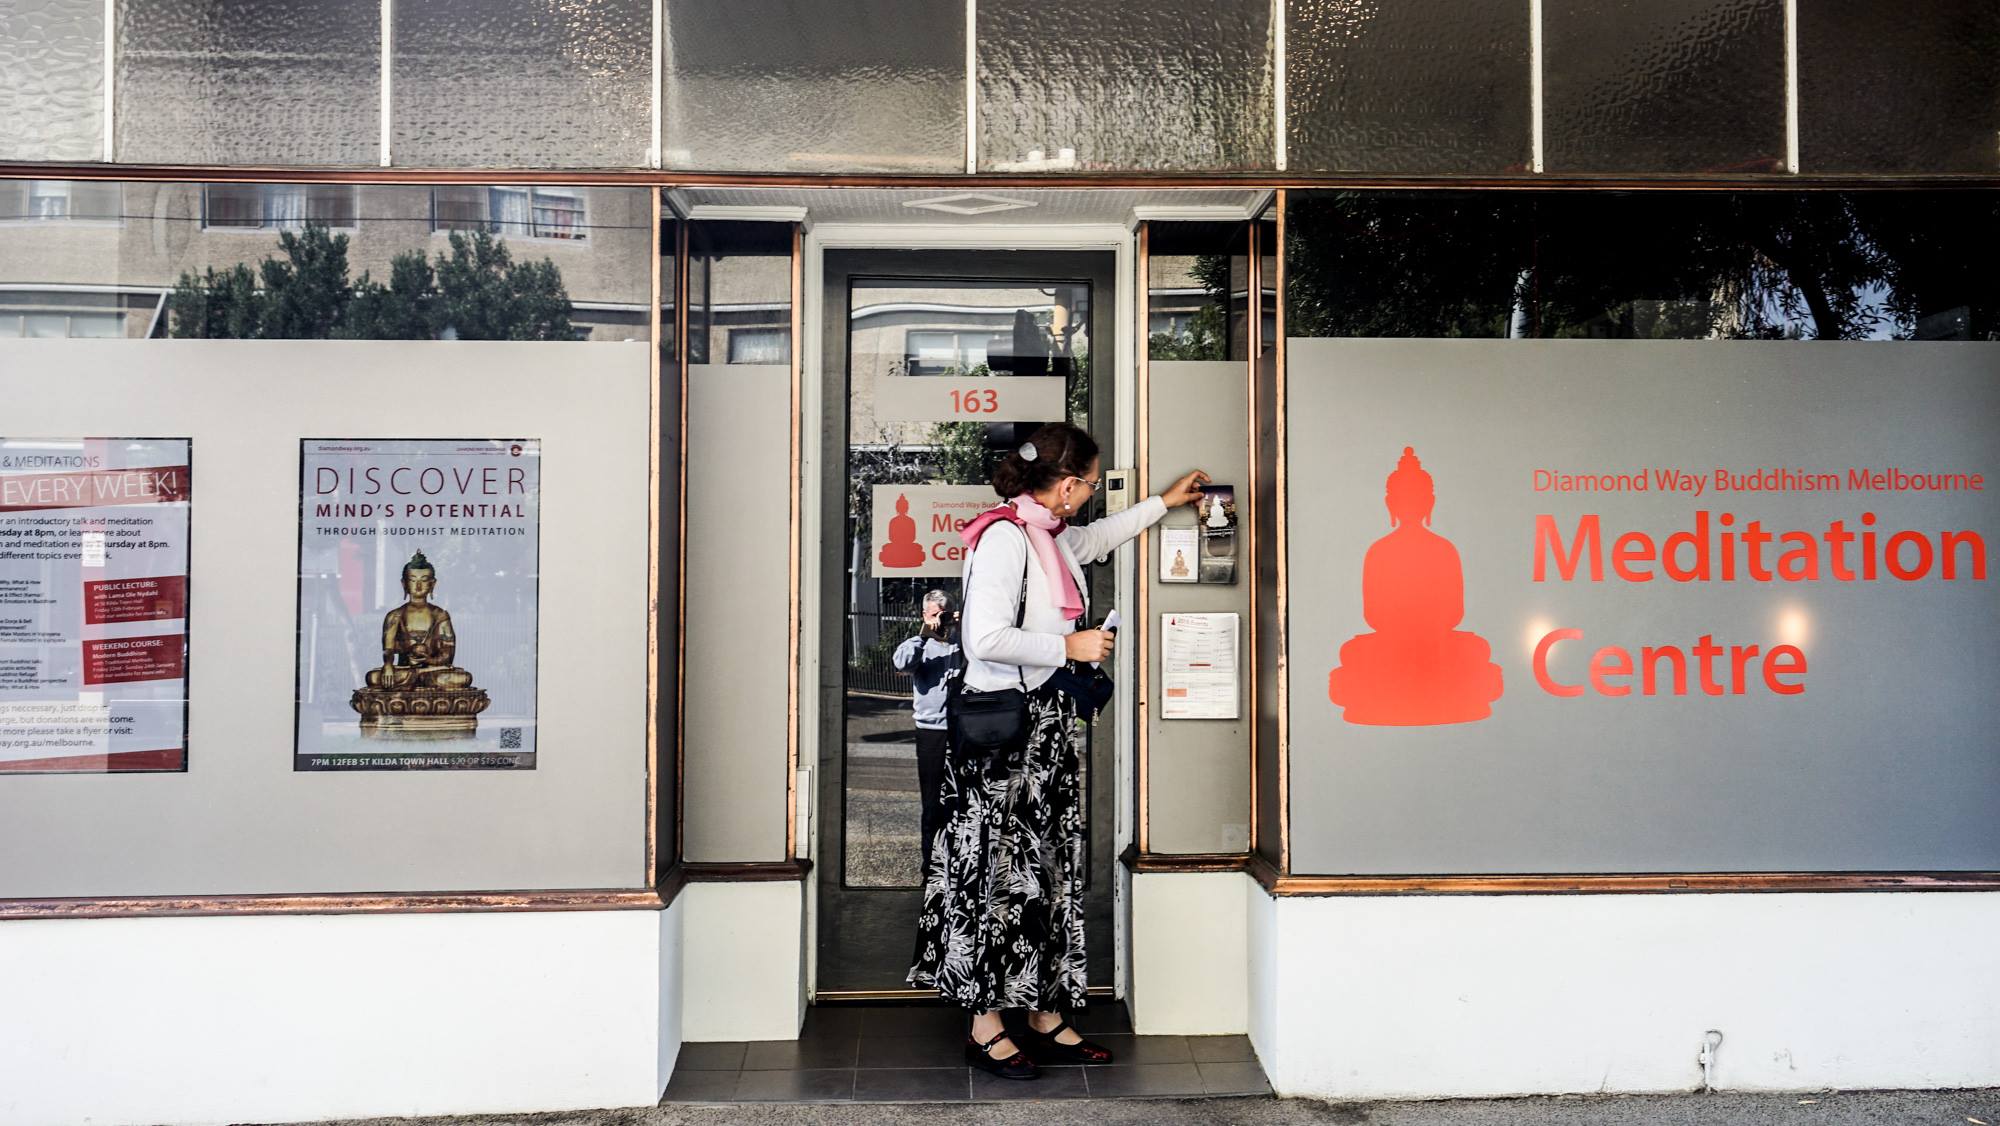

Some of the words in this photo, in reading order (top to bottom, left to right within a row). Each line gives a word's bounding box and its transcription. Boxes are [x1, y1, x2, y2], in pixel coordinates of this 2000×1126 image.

[949, 389, 999, 413] 163
[3, 456, 12, 467] &
[15, 455, 100, 468] MEDITATIONS
[316, 467, 526, 495] DISCOVER
[1533, 469, 1649, 492] Diamond
[1655, 469, 1707, 497] Way
[1715, 468, 1840, 491] Buddhism
[1848, 468, 1985, 491] Melbourne
[3, 475, 88, 505] EVERY
[93, 471, 177, 499] WEEK!
[932, 501, 965, 509] Diamond
[966, 501, 980, 510] Way
[316, 504, 394, 518] MIND'S
[406, 504, 525, 518] POTENTIAL
[18, 517, 70, 527] introductory
[72, 517, 87, 525] talk
[90, 517, 106, 525] and
[107, 517, 153, 525] meditation
[35, 528, 57, 538] 8pm,
[116, 528, 141, 537] about
[316, 527, 376, 536] THROUGH
[382, 527, 445, 536] BUDDHIST
[450, 527, 525, 536] MEDITATION
[148, 540, 170, 549] 8pm.
[1532, 510, 1987, 582] Meditation
[0, 551, 34, 559] different
[36, 552, 62, 560] topics
[94, 583, 120, 591] PUBLIC
[122, 581, 158, 590] LECTURE:
[92, 642, 129, 650] WEEKEND
[131, 640, 163, 649] COURSE:
[1532, 628, 1808, 698] Centre
[36, 715, 79, 723] donations
[27, 727, 55, 737] please
[56, 727, 74, 735] take
[83, 726, 102, 736] flyer
[311, 758, 329, 766] 7PM
[332, 758, 358, 766] 12FEB
[371, 758, 398, 766] KILDA
[399, 757, 425, 765] TOWN
[427, 757, 449, 765] HALL
